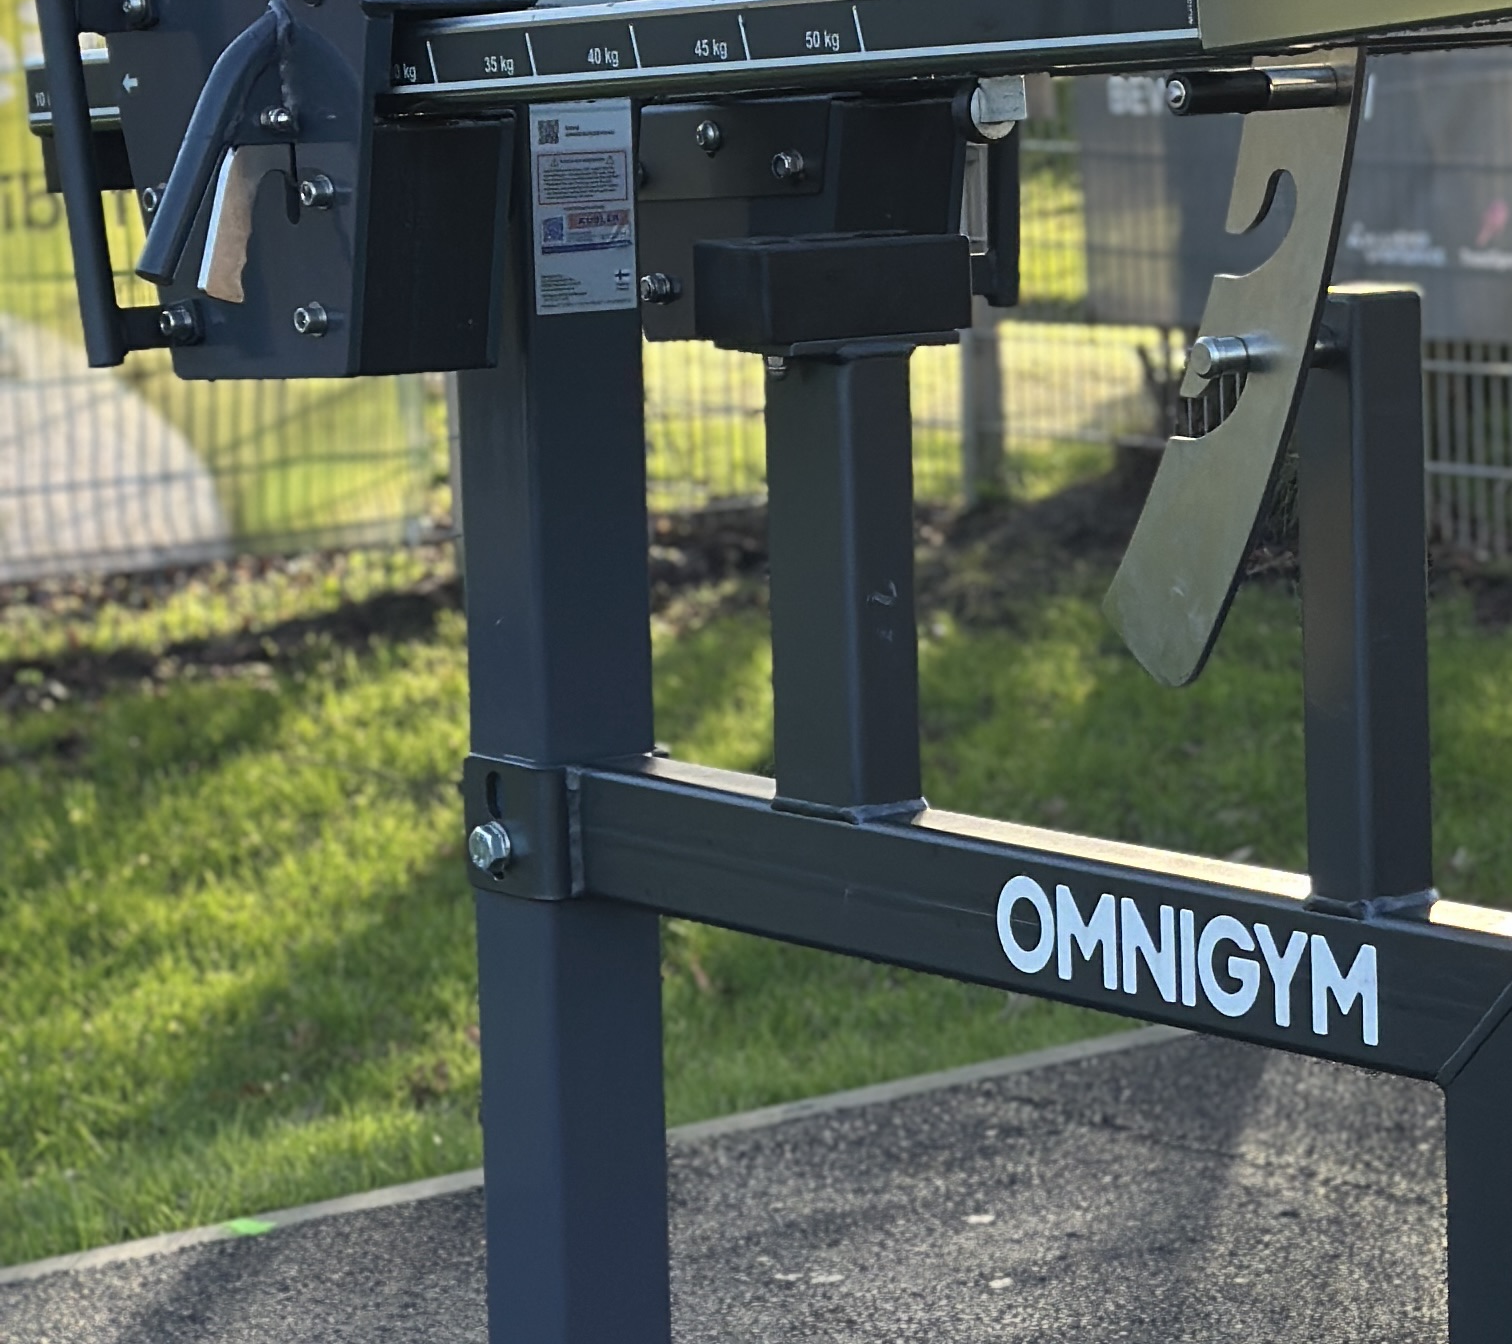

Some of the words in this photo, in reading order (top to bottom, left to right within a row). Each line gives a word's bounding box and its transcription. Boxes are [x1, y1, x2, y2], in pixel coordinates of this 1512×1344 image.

[403, 62, 417, 83] kg
[484, 56, 498, 73] 35
[500, 55, 514, 76] kg
[587, 47, 602, 65] 40
[605, 47, 619, 67] kg
[694, 39, 709, 57] 45
[712, 38, 728, 60] kg
[805, 30, 820, 49] 50
[824, 30, 840, 51] kg
[996, 874, 1380, 1048] OMNIGYM
